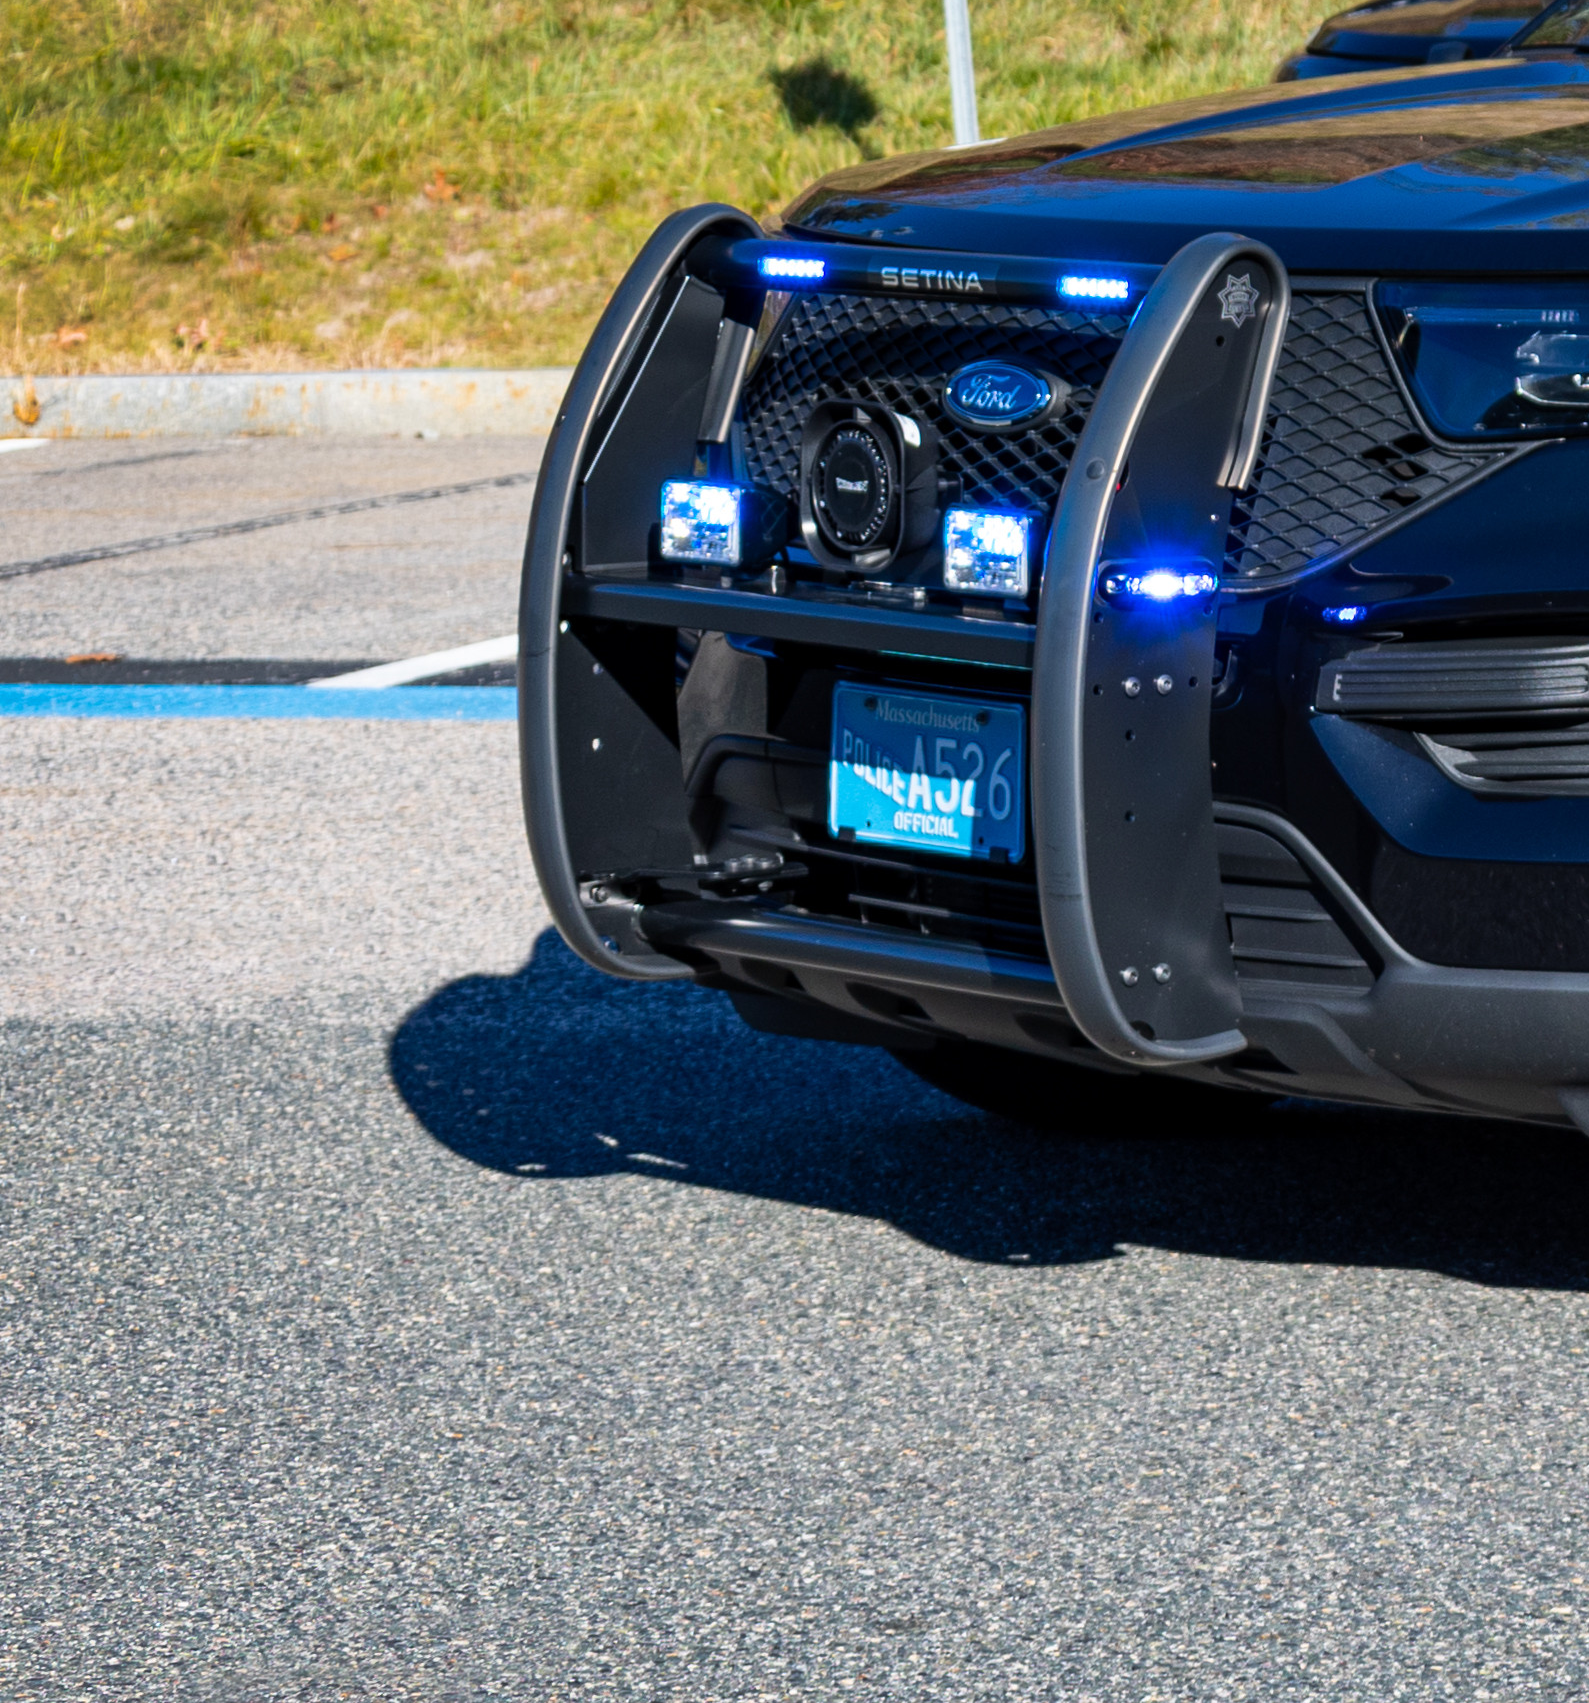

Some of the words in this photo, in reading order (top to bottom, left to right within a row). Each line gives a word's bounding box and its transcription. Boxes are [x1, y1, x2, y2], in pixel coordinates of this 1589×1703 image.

[881, 266, 984, 292] SETINA
[961, 373, 1022, 410] Ford
[875, 698, 981, 734] Massachusetts
[842, 728, 906, 807] POLICE
[906, 735, 1012, 822] A526
[894, 810, 959, 840] OFFICIAL
